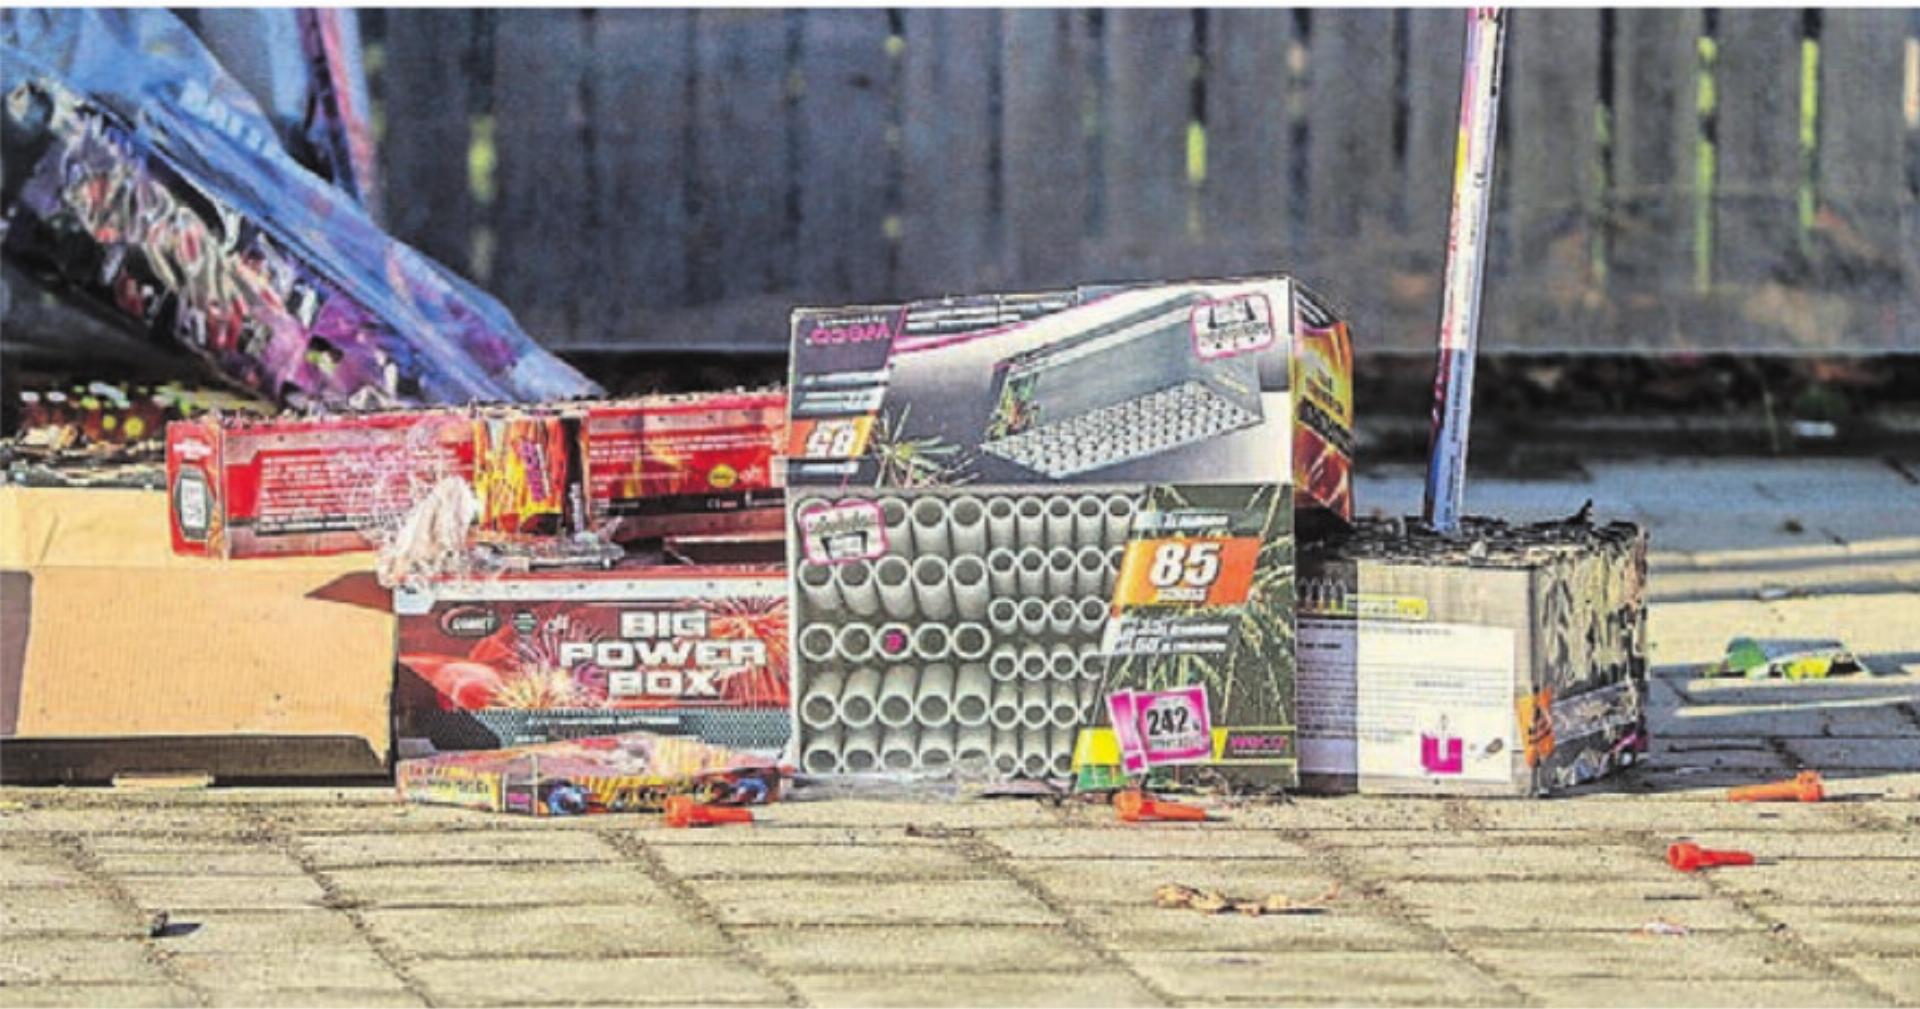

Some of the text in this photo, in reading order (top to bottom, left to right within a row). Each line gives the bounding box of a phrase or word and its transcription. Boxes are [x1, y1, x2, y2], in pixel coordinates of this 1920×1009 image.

[1149, 542, 1222, 587] 85
[621, 610, 706, 638] BIG
[559, 637, 767, 668] POWER
[608, 669, 720, 697] BOX
[1146, 705, 1190, 736] 242
